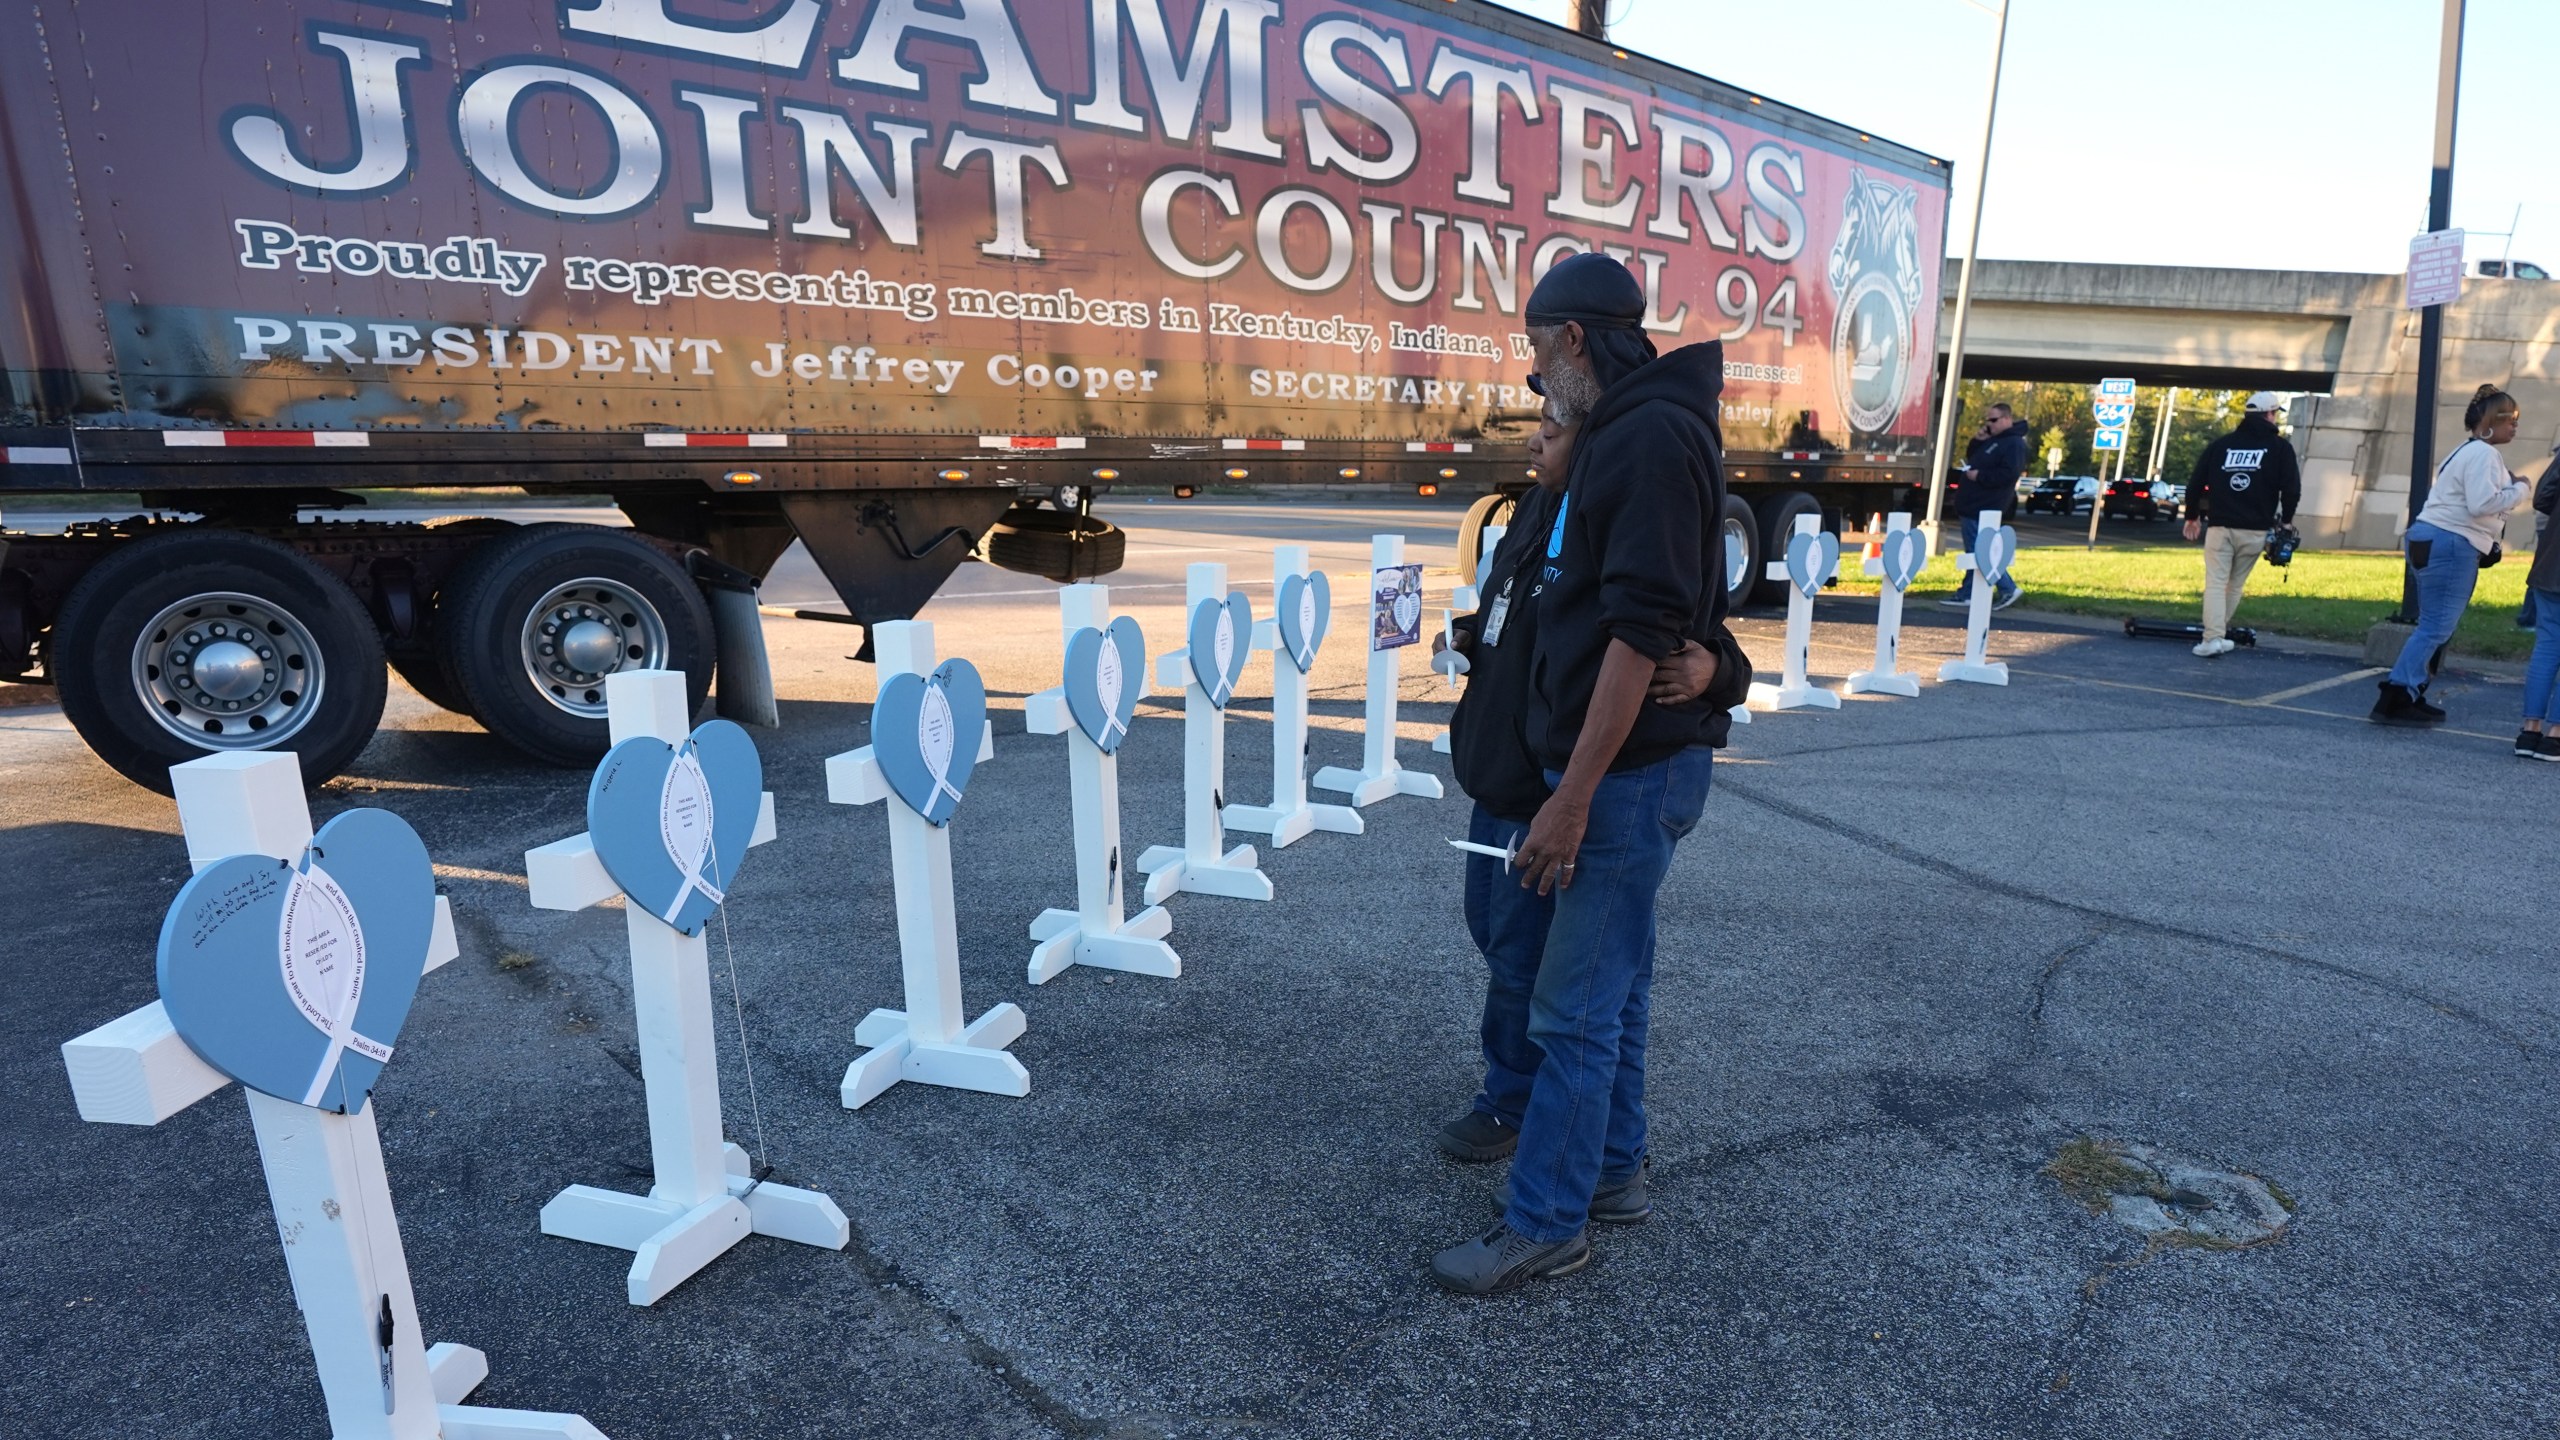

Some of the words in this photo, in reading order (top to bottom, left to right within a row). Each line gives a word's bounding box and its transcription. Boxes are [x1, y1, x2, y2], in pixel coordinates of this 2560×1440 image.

[398, 0, 1805, 264] AMSTERS
[231, 31, 1071, 259] JOINT
[1140, 170, 1687, 334] COUNL
[1716, 268, 1803, 347] 94
[237, 220, 545, 295] Proudly
[564, 256, 937, 320] representing
[949, 288, 1149, 328] members
[1160, 297, 1201, 333] in
[1210, 303, 1381, 352] Kentucky,
[1390, 321, 1503, 361] Indiana,
[233, 316, 723, 375] PRESIDENT
[750, 343, 964, 393] Jeffrey
[987, 354, 1158, 398] Cooper
[1250, 368, 1546, 409] SECRETARY-TRE
[1722, 361, 1802, 384] ennessee!
[2105, 381, 2131, 393] WEST
[1719, 400, 1773, 428] arley
[2097, 404, 2130, 420] 264
[2229, 451, 2260, 465] TDFN
[325, 883, 338, 897] and
[194, 898, 220, 922] With
[335, 895, 350, 915] saves
[284, 882, 303, 952] brokenhearted
[347, 914, 356, 929] the
[318, 929, 331, 940] AREA
[327, 937, 338, 948] FOR
[352, 928, 363, 964] crushed
[284, 954, 292, 969] the
[356, 965, 363, 975] in
[288, 970, 295, 981] to
[291, 981, 304, 999] near
[350, 976, 361, 1001] spirit.
[301, 998, 308, 1008] is
[305, 1004, 322, 1021] Lord
[320, 1017, 333, 1031] The
[352, 1036, 370, 1052] Psalm
[369, 1045, 387, 1059] 34:18
